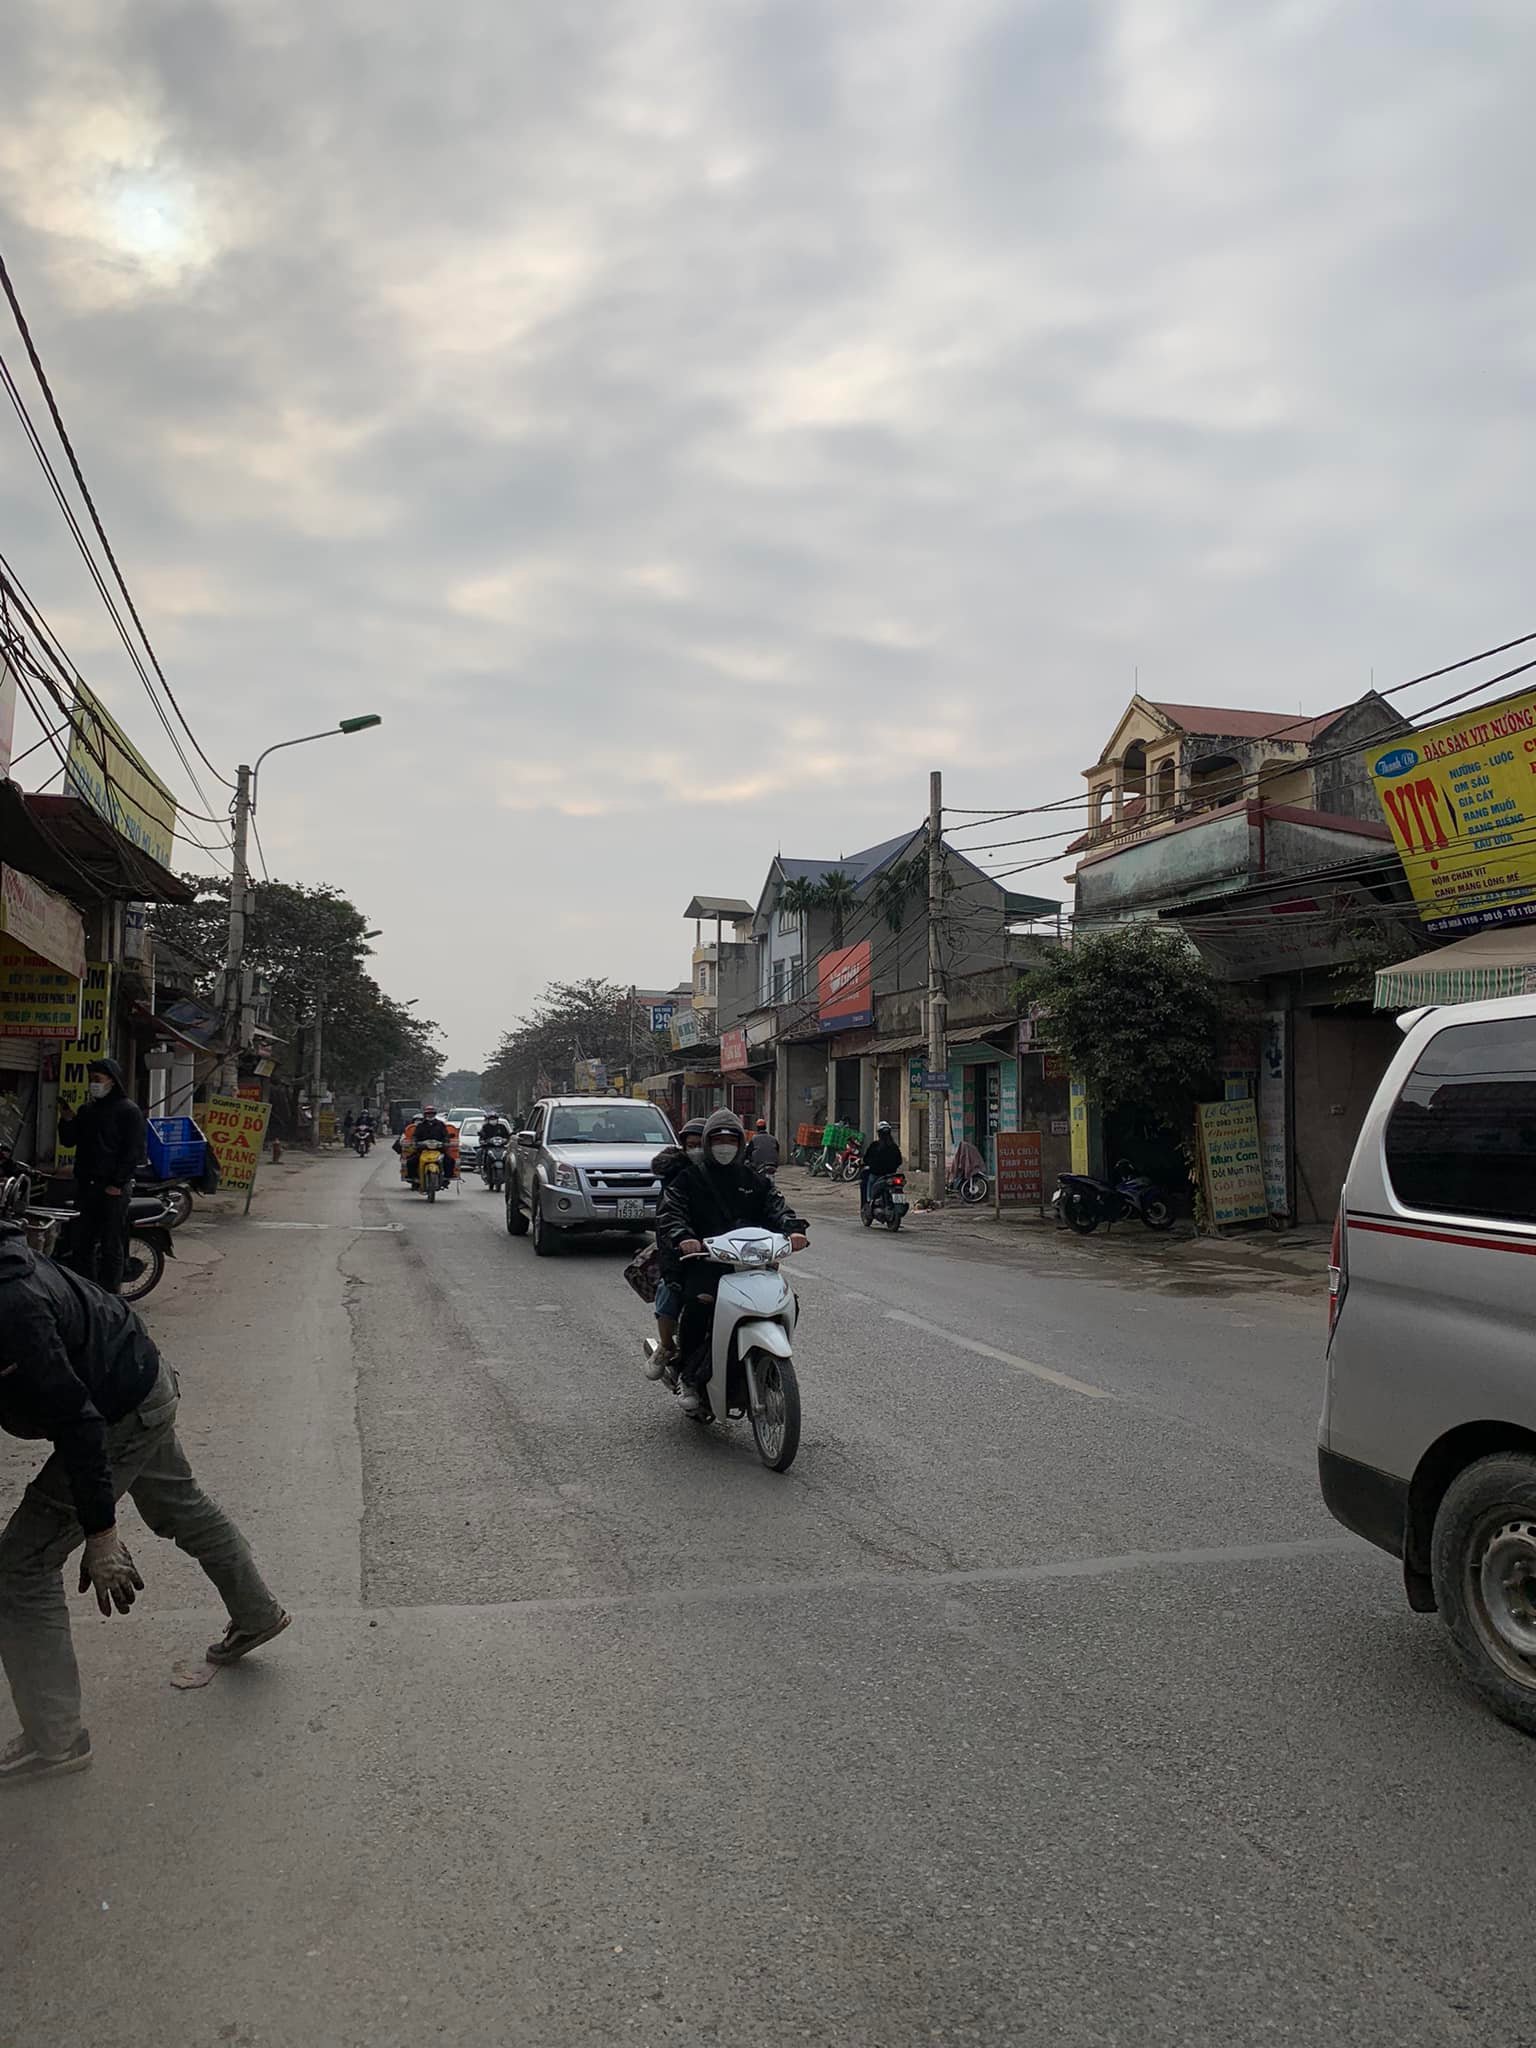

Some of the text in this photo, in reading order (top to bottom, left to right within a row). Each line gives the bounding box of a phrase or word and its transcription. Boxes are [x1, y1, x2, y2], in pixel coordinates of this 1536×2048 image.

[1470, 724, 1489, 748] VỊT
[1490, 709, 1533, 737] NƯỚNG
[1454, 781, 1470, 793] OM
[1384, 777, 1449, 870] VỊT
[83, 1000, 103, 1020] NG
[656, 1013, 671, 1029] 29
[208, 1109, 241, 1127] PHỞ
[211, 1131, 250, 1148] GÀ
[226, 1147, 256, 1164] RANG
